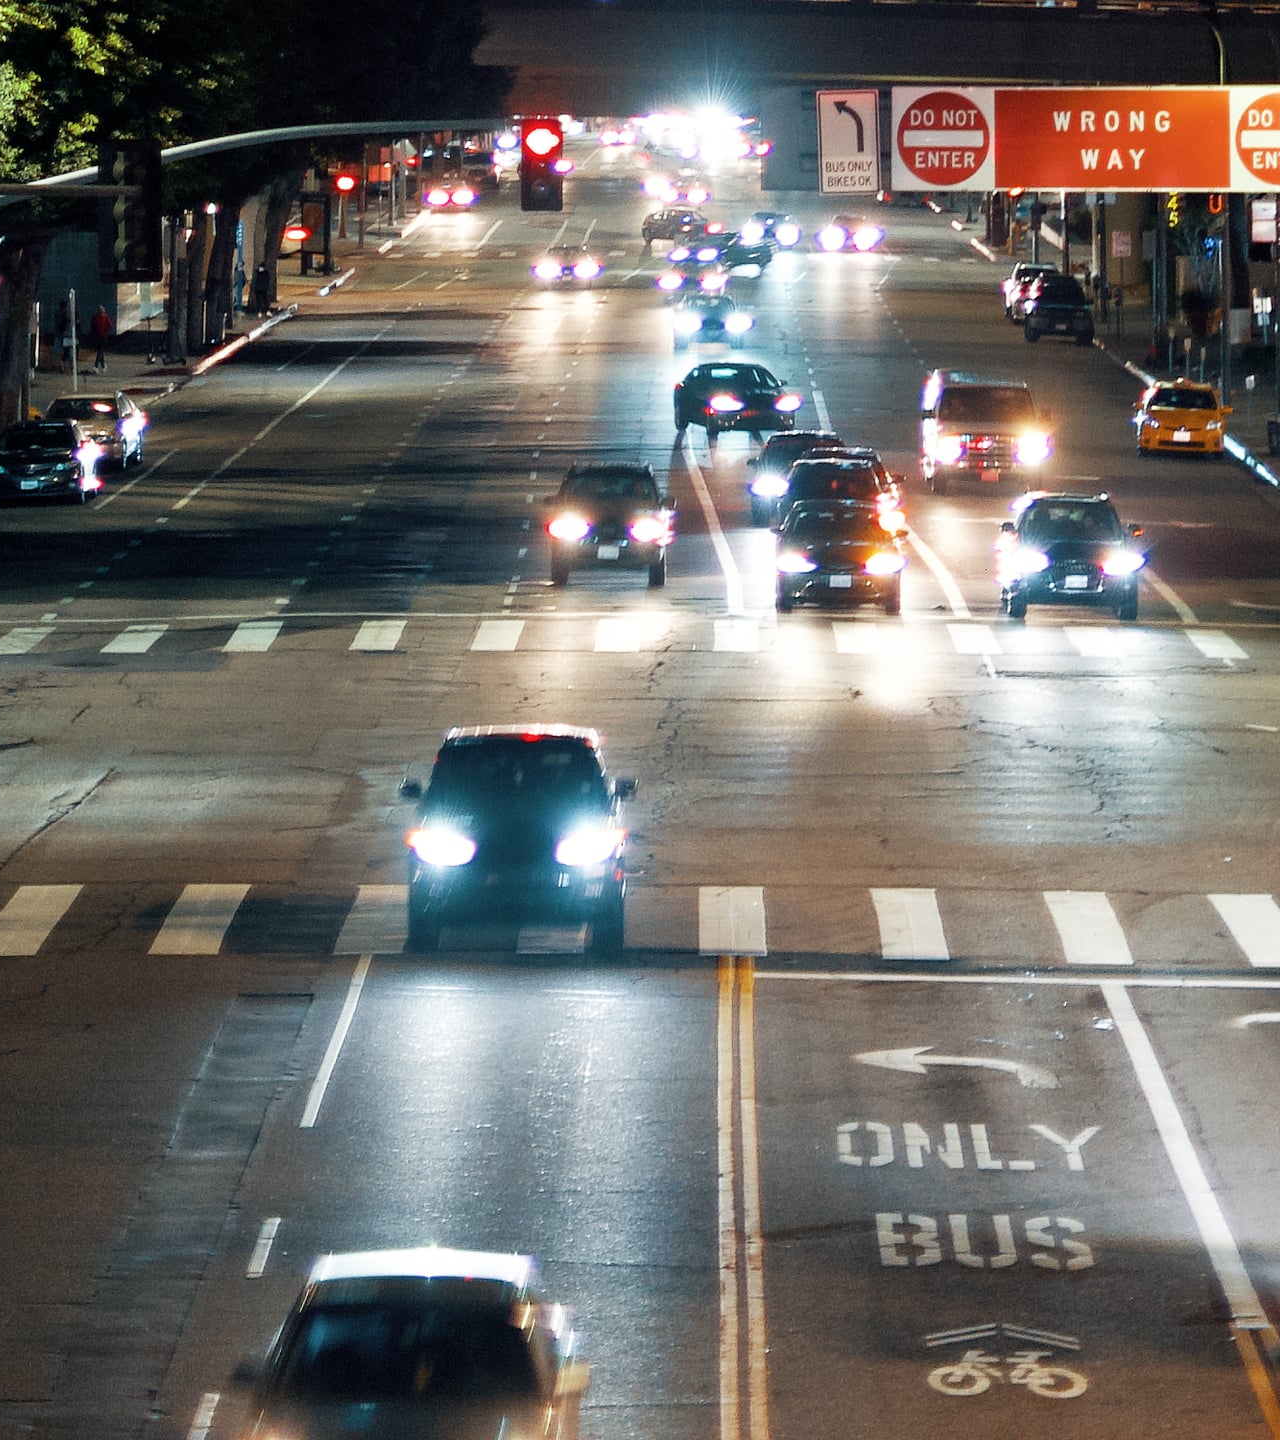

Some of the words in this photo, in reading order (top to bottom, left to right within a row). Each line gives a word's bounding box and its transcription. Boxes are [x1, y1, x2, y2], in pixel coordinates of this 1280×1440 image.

[910, 110, 935, 126] DO
[942, 110, 977, 126] NOT
[1053, 110, 1171, 132] WRONG
[1248, 109, 1271, 128] DO
[825, 161, 845, 172] BUS
[848, 161, 873, 172] ONLY
[915, 151, 975, 168] ENTER
[1081, 149, 1145, 170] WAY
[827, 176, 856, 188] BIKES
[858, 176, 872, 186] OK
[836, 1121, 1101, 1171] ONLY
[875, 1213, 1095, 1271] BUS
